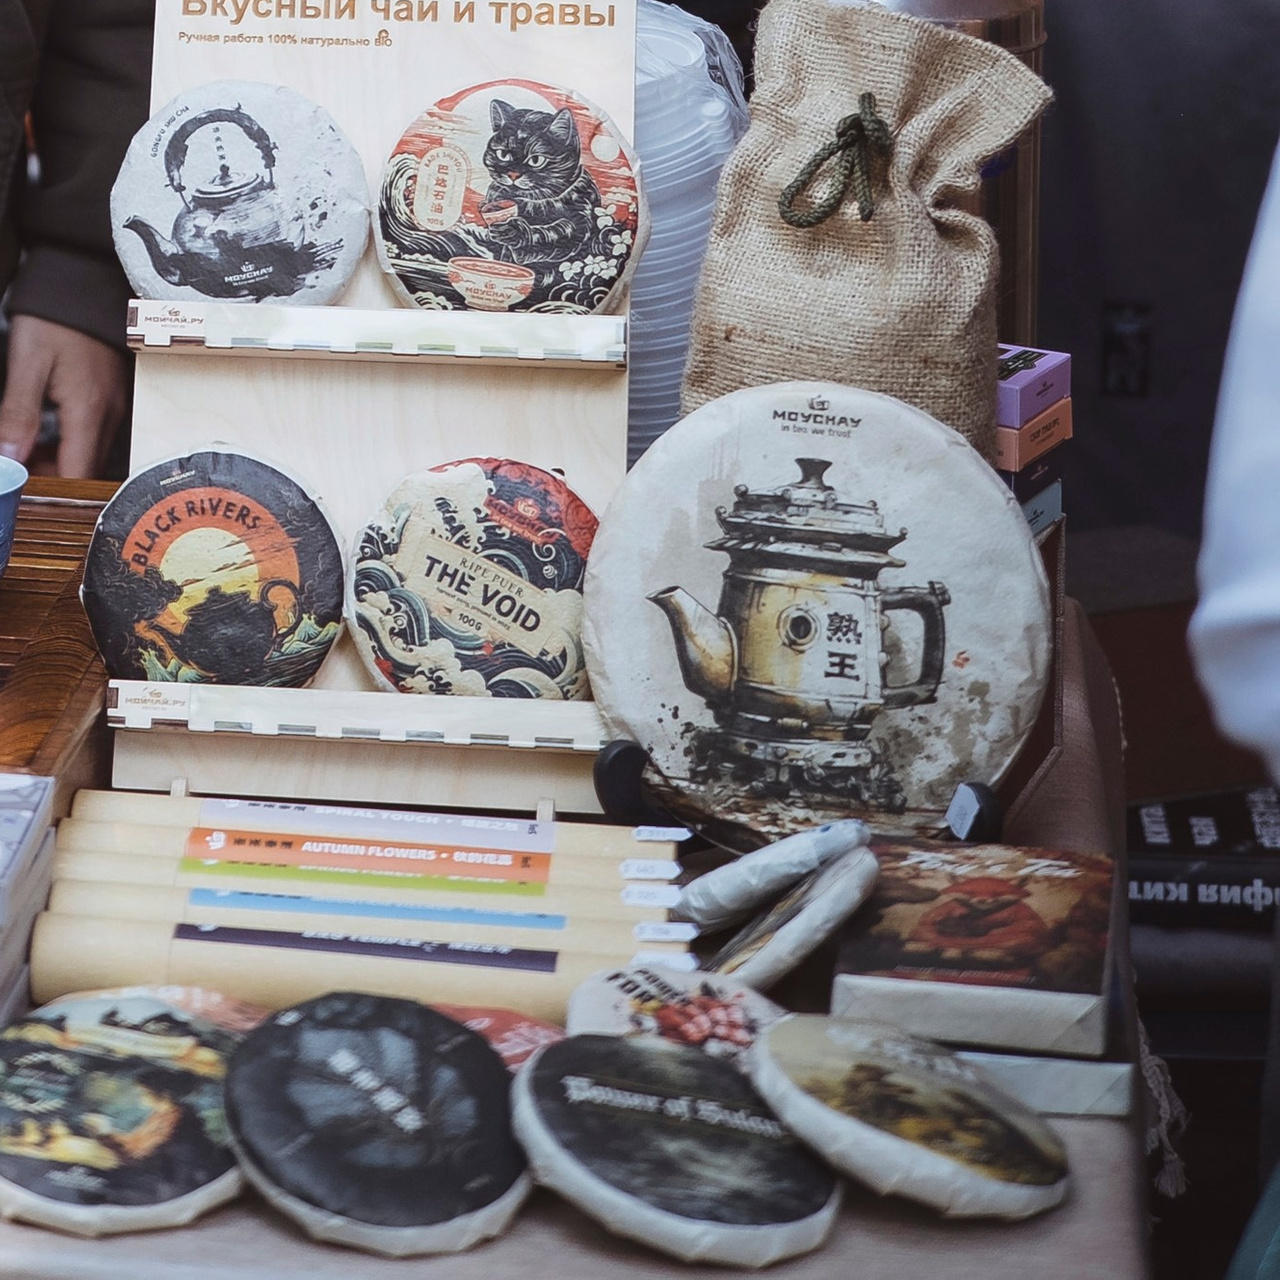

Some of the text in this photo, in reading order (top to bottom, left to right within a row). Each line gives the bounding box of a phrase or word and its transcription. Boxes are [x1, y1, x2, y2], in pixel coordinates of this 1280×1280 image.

[452, 2, 475, 24] и
[489, 1, 616, 32] травы
[178, 31, 220, 44] Ручная
[223, 33, 264, 45] работа
[267, 33, 297, 45] 100%
[300, 35, 370, 48] натурально
[224, 265, 273, 283] MOYCHAY
[772, 409, 862, 428] MOYCHAY
[131, 496, 262, 567] BLACK RIVERS
[424, 554, 541, 632] THE VOID
[459, 556, 524, 599] RIPE PUER
[823, 611, 863, 682] 熟王
[381, 811, 439, 824] TOUCH
[301, 841, 437, 861] AUTUMN FLOWERS
[1197, 878, 1280, 913] фия
